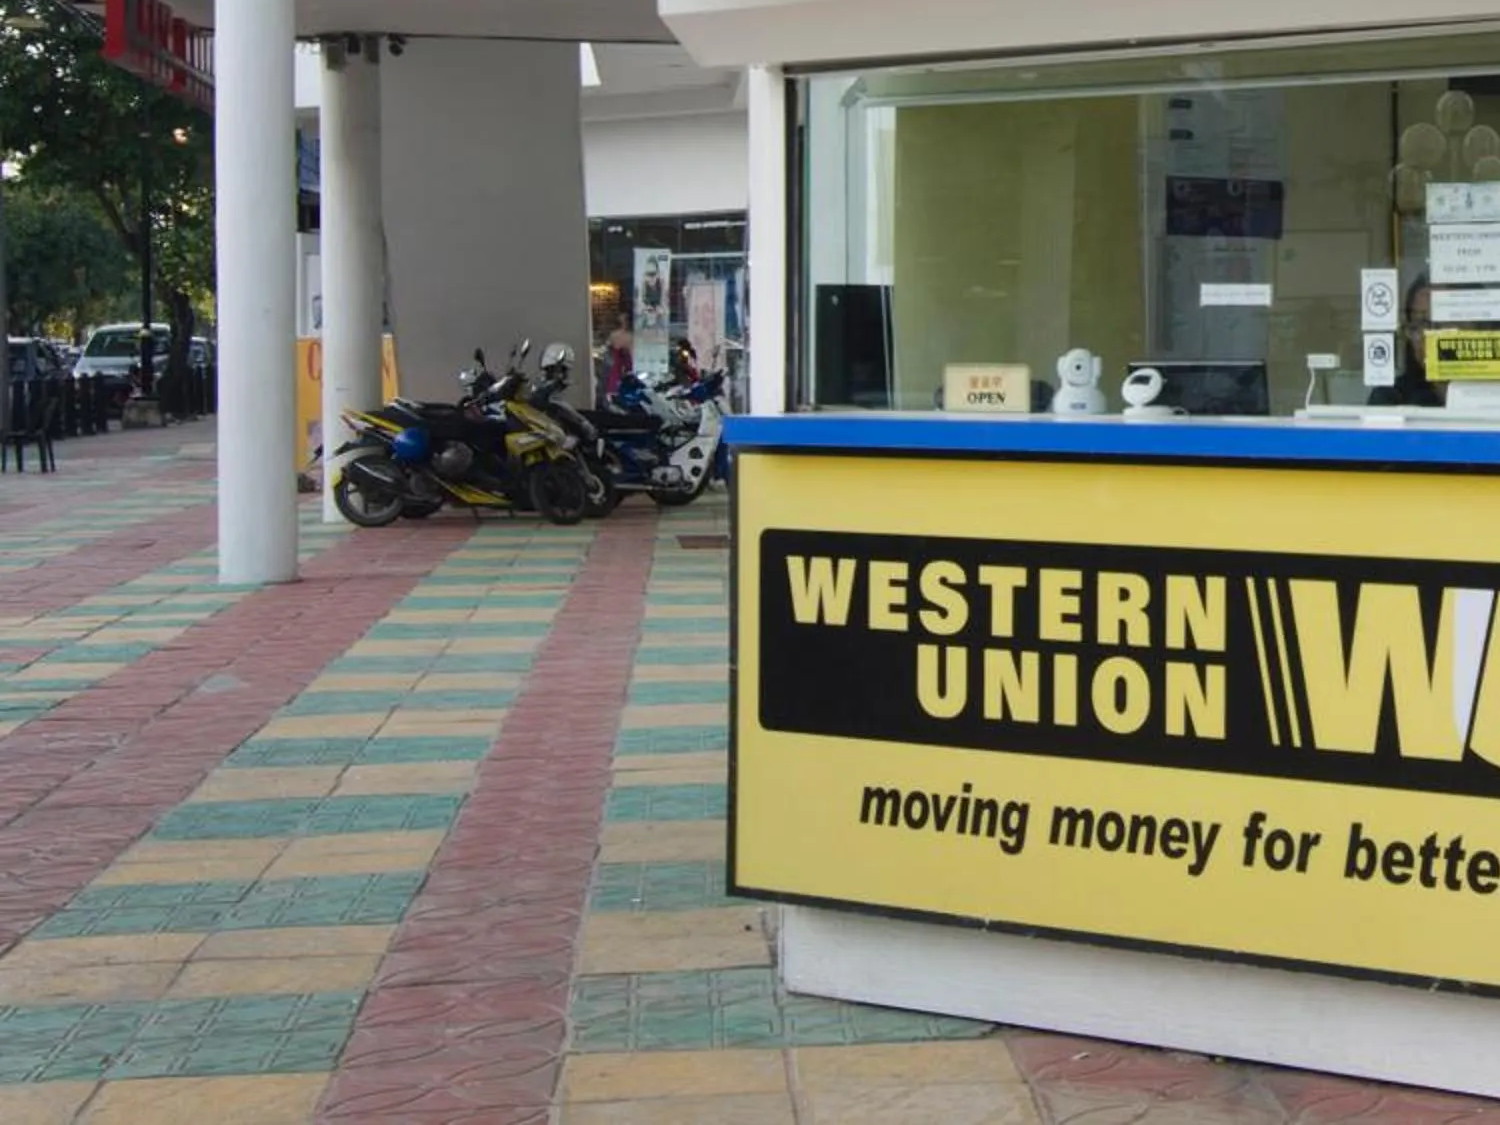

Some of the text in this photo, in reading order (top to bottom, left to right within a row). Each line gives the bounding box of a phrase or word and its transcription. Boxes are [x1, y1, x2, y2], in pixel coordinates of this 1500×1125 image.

[967, 391, 1006, 405] OPEN
[785, 554, 1227, 653] WESTERN
[915, 644, 1227, 741] UNION
[859, 779, 1031, 856] moving
[1049, 803, 1221, 876] money
[1242, 810, 1322, 874] for
